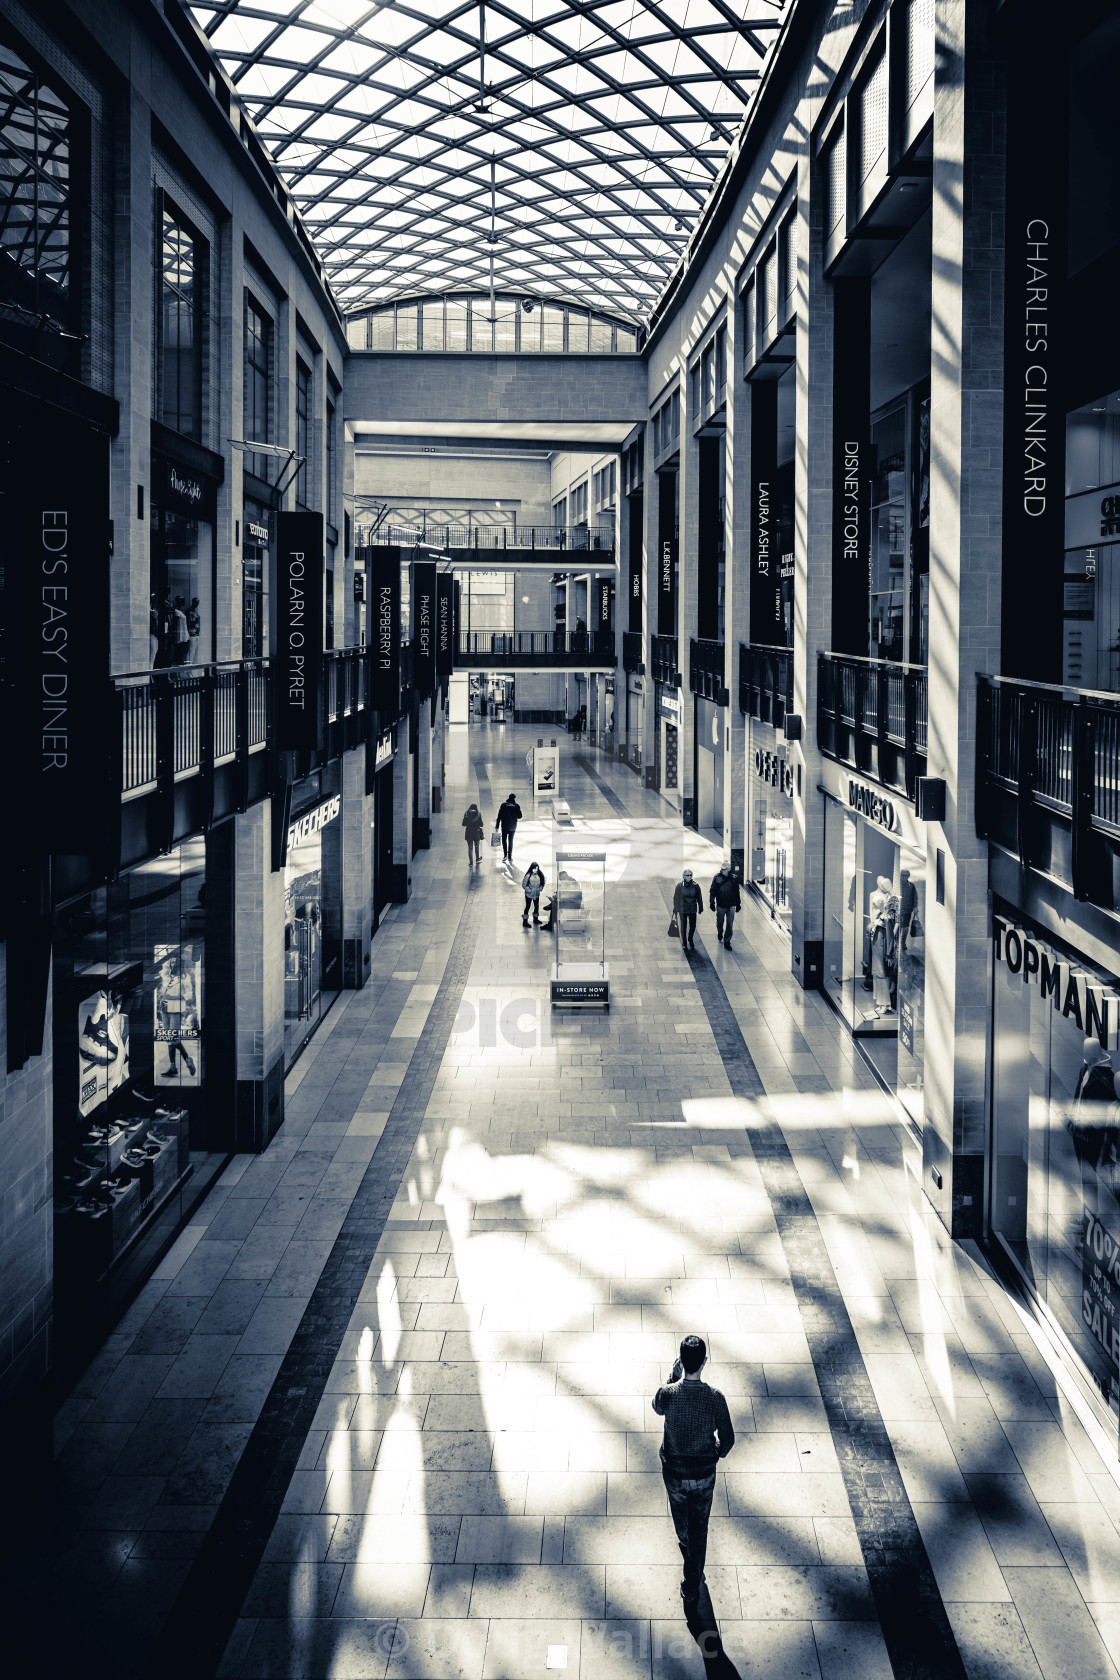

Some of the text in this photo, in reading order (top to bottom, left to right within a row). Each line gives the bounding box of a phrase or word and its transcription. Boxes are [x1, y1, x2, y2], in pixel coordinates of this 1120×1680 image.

[1024, 219, 1049, 517] CHARLES CLINKARD
[758, 482, 769, 577] LAURA ASHLEY
[844, 441, 859, 559] DISNEY STORE
[41, 510, 68, 772] ED'S EASY DINER
[289, 552, 305, 710] POLARN O. PYRET
[379, 587, 391, 669] RASPBERRY PI
[420, 595, 430, 657] PHASE EIGHT
[440, 597, 448, 652] SEAN HANNA
[287, 793, 341, 853] SKECHERS
[848, 780, 895, 832] MANGO
[993, 915, 1119, 1051] TOPMAN
[1084, 1207, 1120, 1287] 70%
[1093, 1264, 1111, 1294] UP TO
[1083, 1289, 1120, 1368] SALE
[1090, 1274, 1116, 1318] 70% OFF
